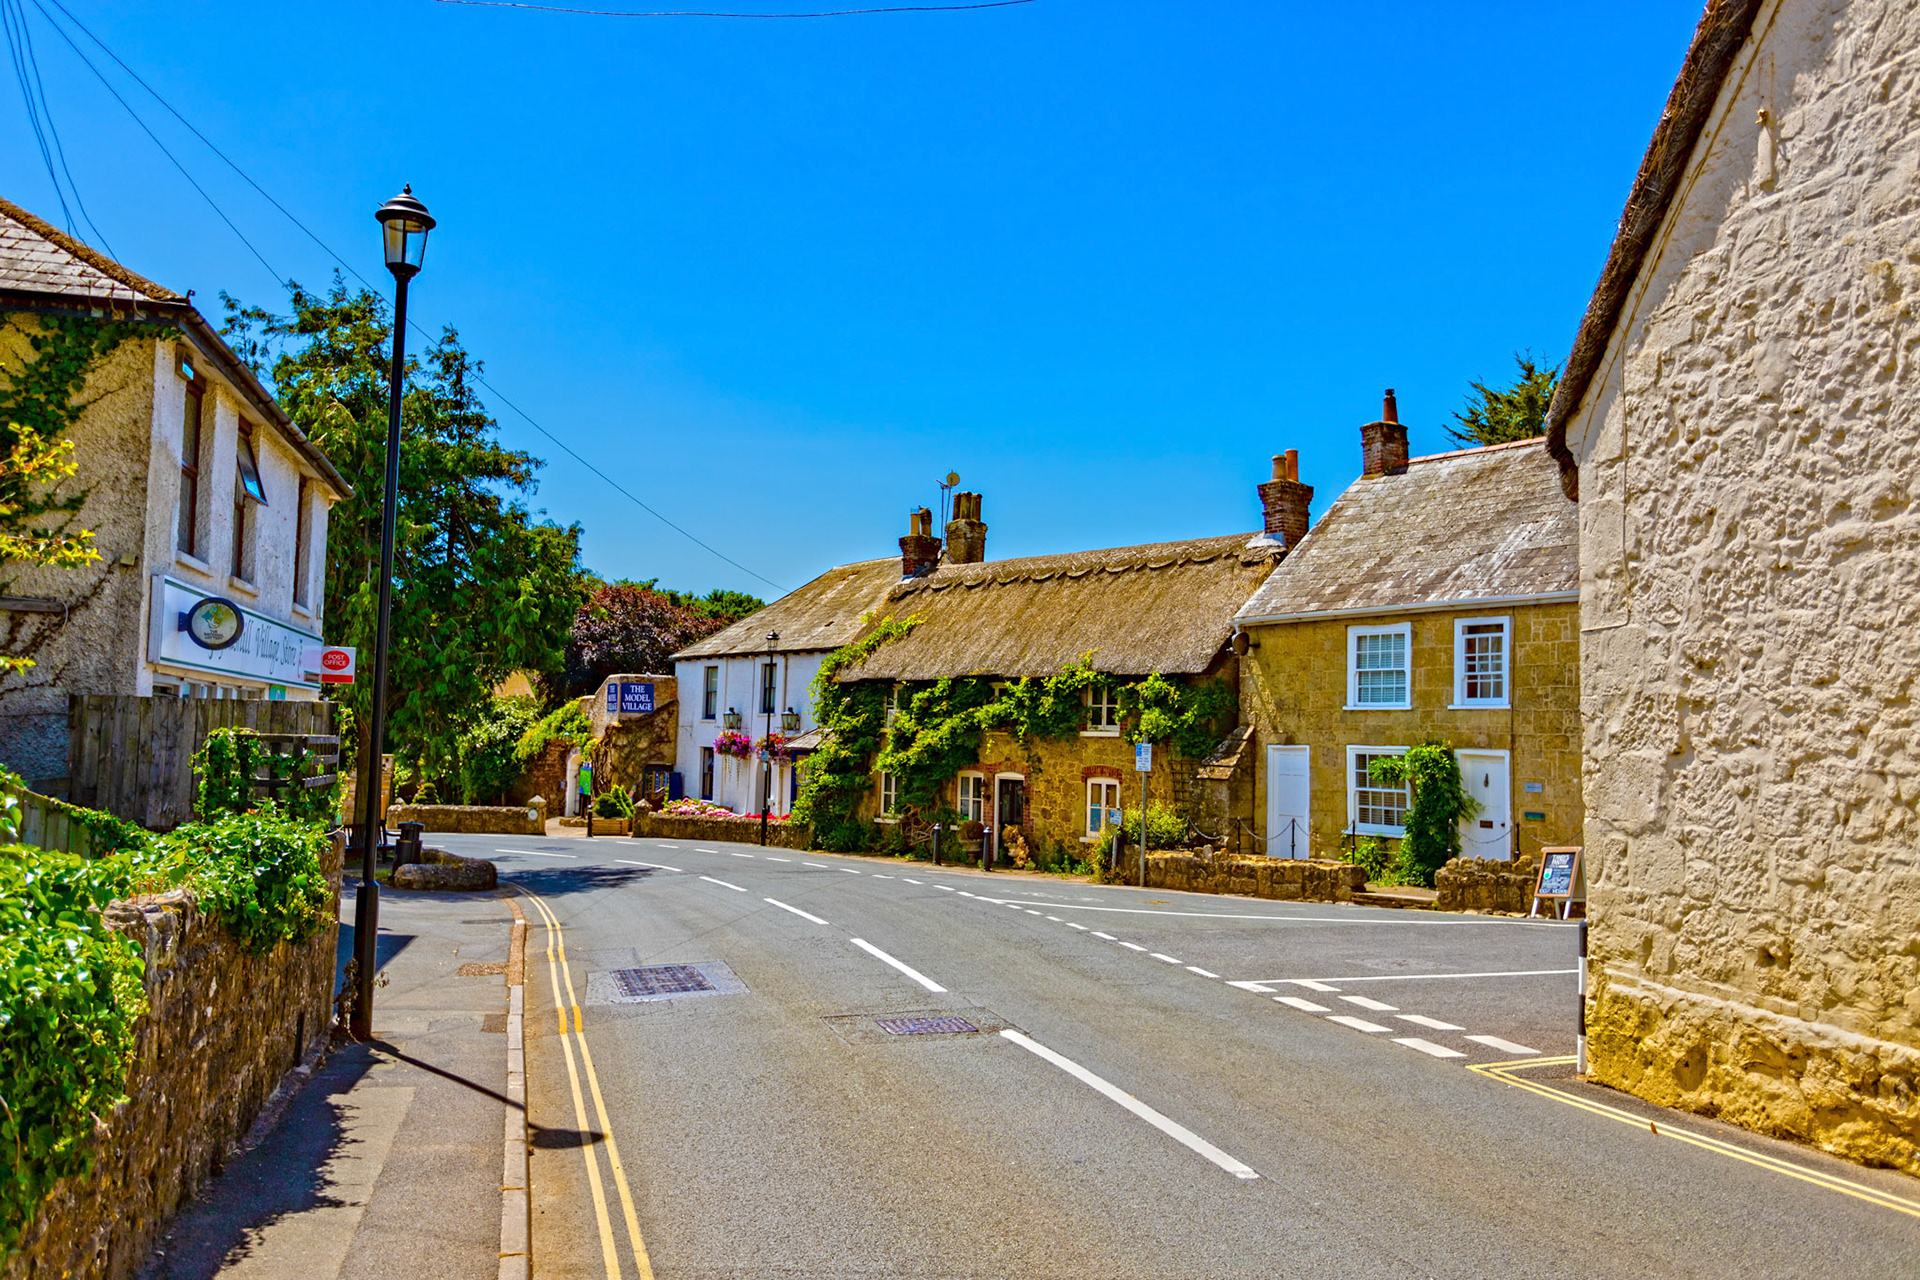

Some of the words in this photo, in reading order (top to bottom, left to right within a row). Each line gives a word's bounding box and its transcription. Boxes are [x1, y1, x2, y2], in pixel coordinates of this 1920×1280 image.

[256, 623, 280, 675] Village
[280, 635, 297, 666] Store
[630, 685, 645, 693] THE
[624, 694, 651, 702] MODEL
[622, 702, 653, 711] VILLAGE
